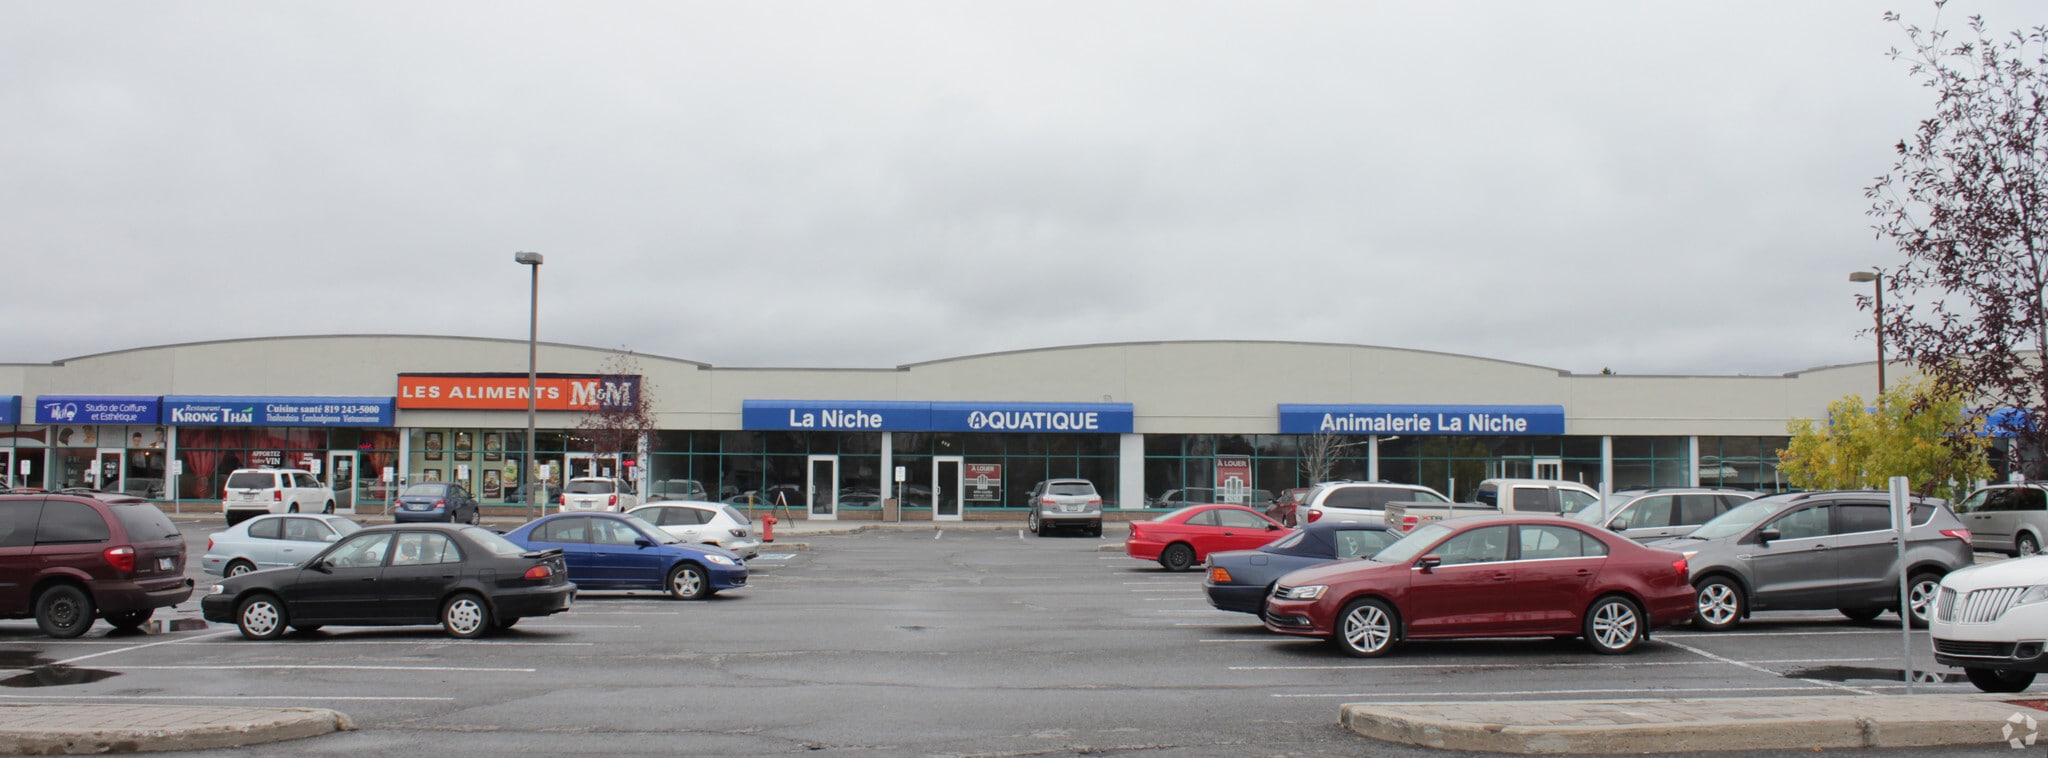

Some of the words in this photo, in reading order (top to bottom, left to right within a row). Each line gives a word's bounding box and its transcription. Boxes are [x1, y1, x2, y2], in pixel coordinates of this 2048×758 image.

[402, 385, 440, 398] LES
[448, 386, 560, 399] ALIMENTS
[570, 381, 631, 407] M&M
[85, 403, 108, 412] Studio
[109, 404, 118, 412] de
[119, 403, 147, 412] Coiffure
[172, 408, 217, 422] KRONG
[266, 404, 299, 413] Cuisine
[300, 405, 322, 414] santé
[324, 405, 340, 414] 819
[341, 405, 380, 414] 243-5000
[789, 409, 814, 428] La
[822, 409, 883, 429] Niche
[967, 410, 1099, 431] AQUATIQUE
[1320, 413, 1431, 432] Animalerie
[1438, 413, 1462, 432] La
[1469, 413, 1527, 432] Niche
[265, 457, 281, 465] VIN
